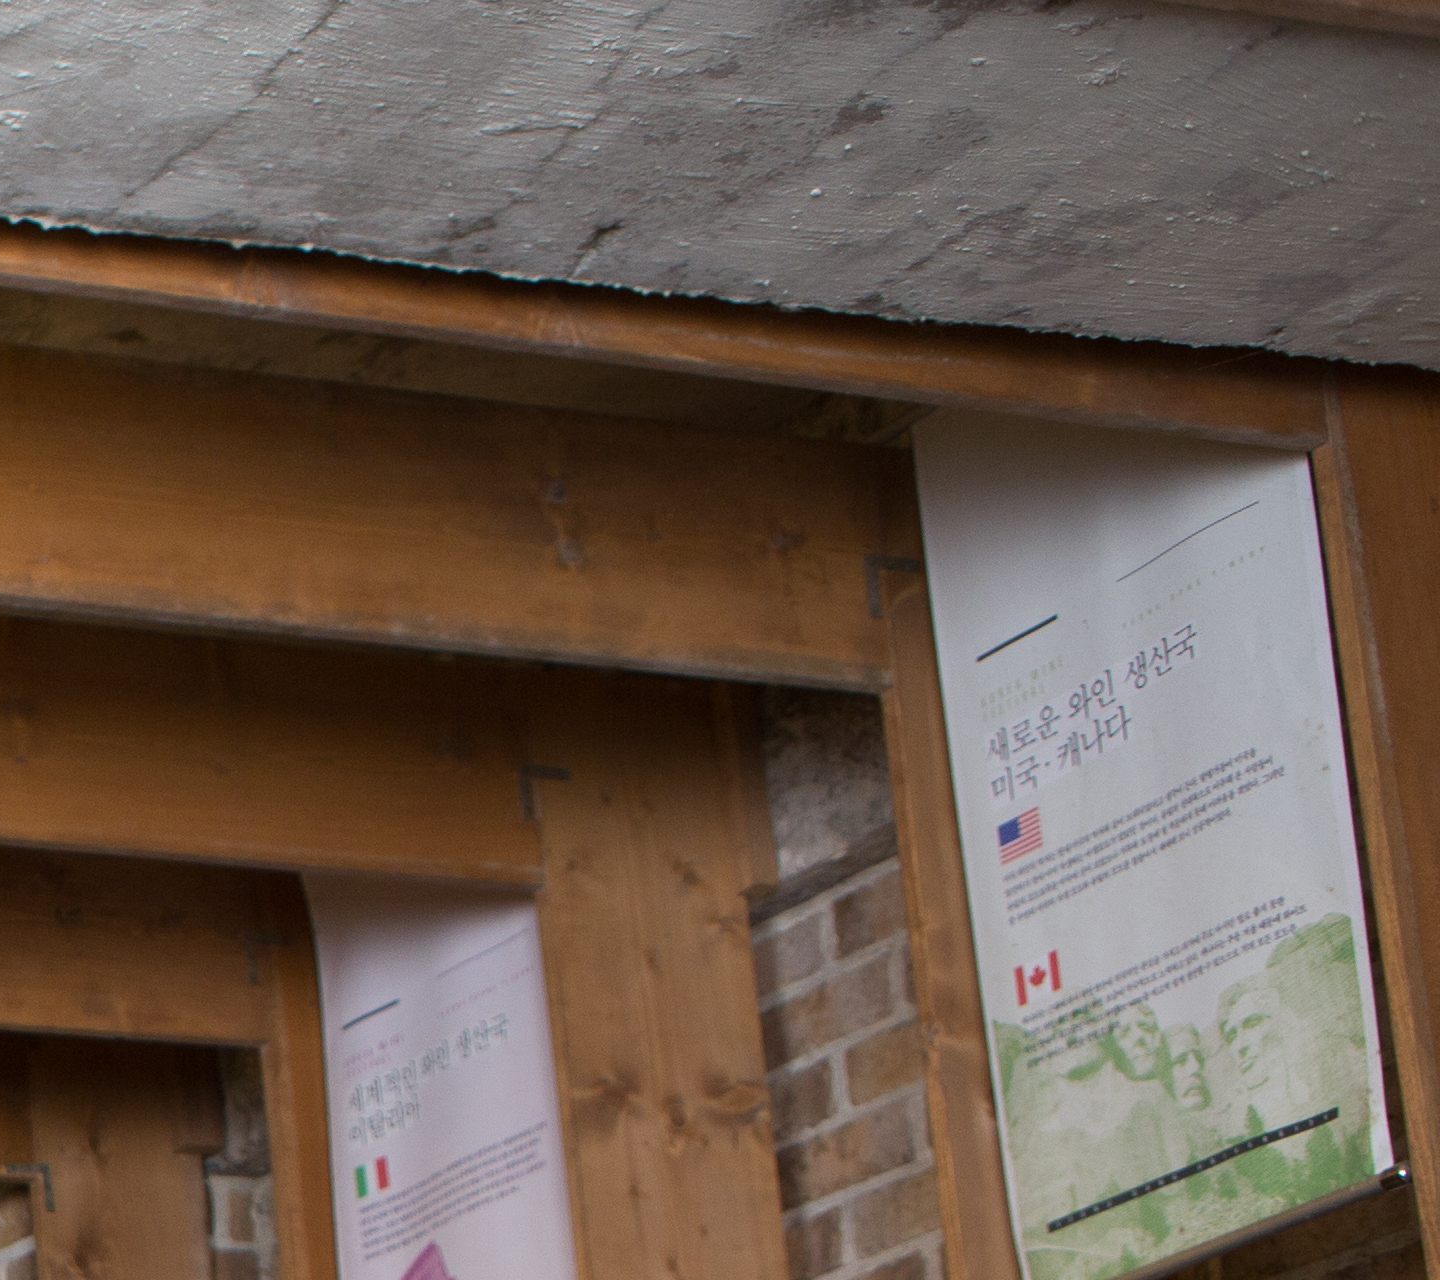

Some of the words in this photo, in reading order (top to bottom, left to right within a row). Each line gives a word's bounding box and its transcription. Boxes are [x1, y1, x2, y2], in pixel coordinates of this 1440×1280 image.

[986, 704, 1061, 762] 새로운
[1068, 668, 1117, 719] 와인
[1125, 623, 1198, 690] 생산국
[456, 1011, 509, 1059] 생산국
